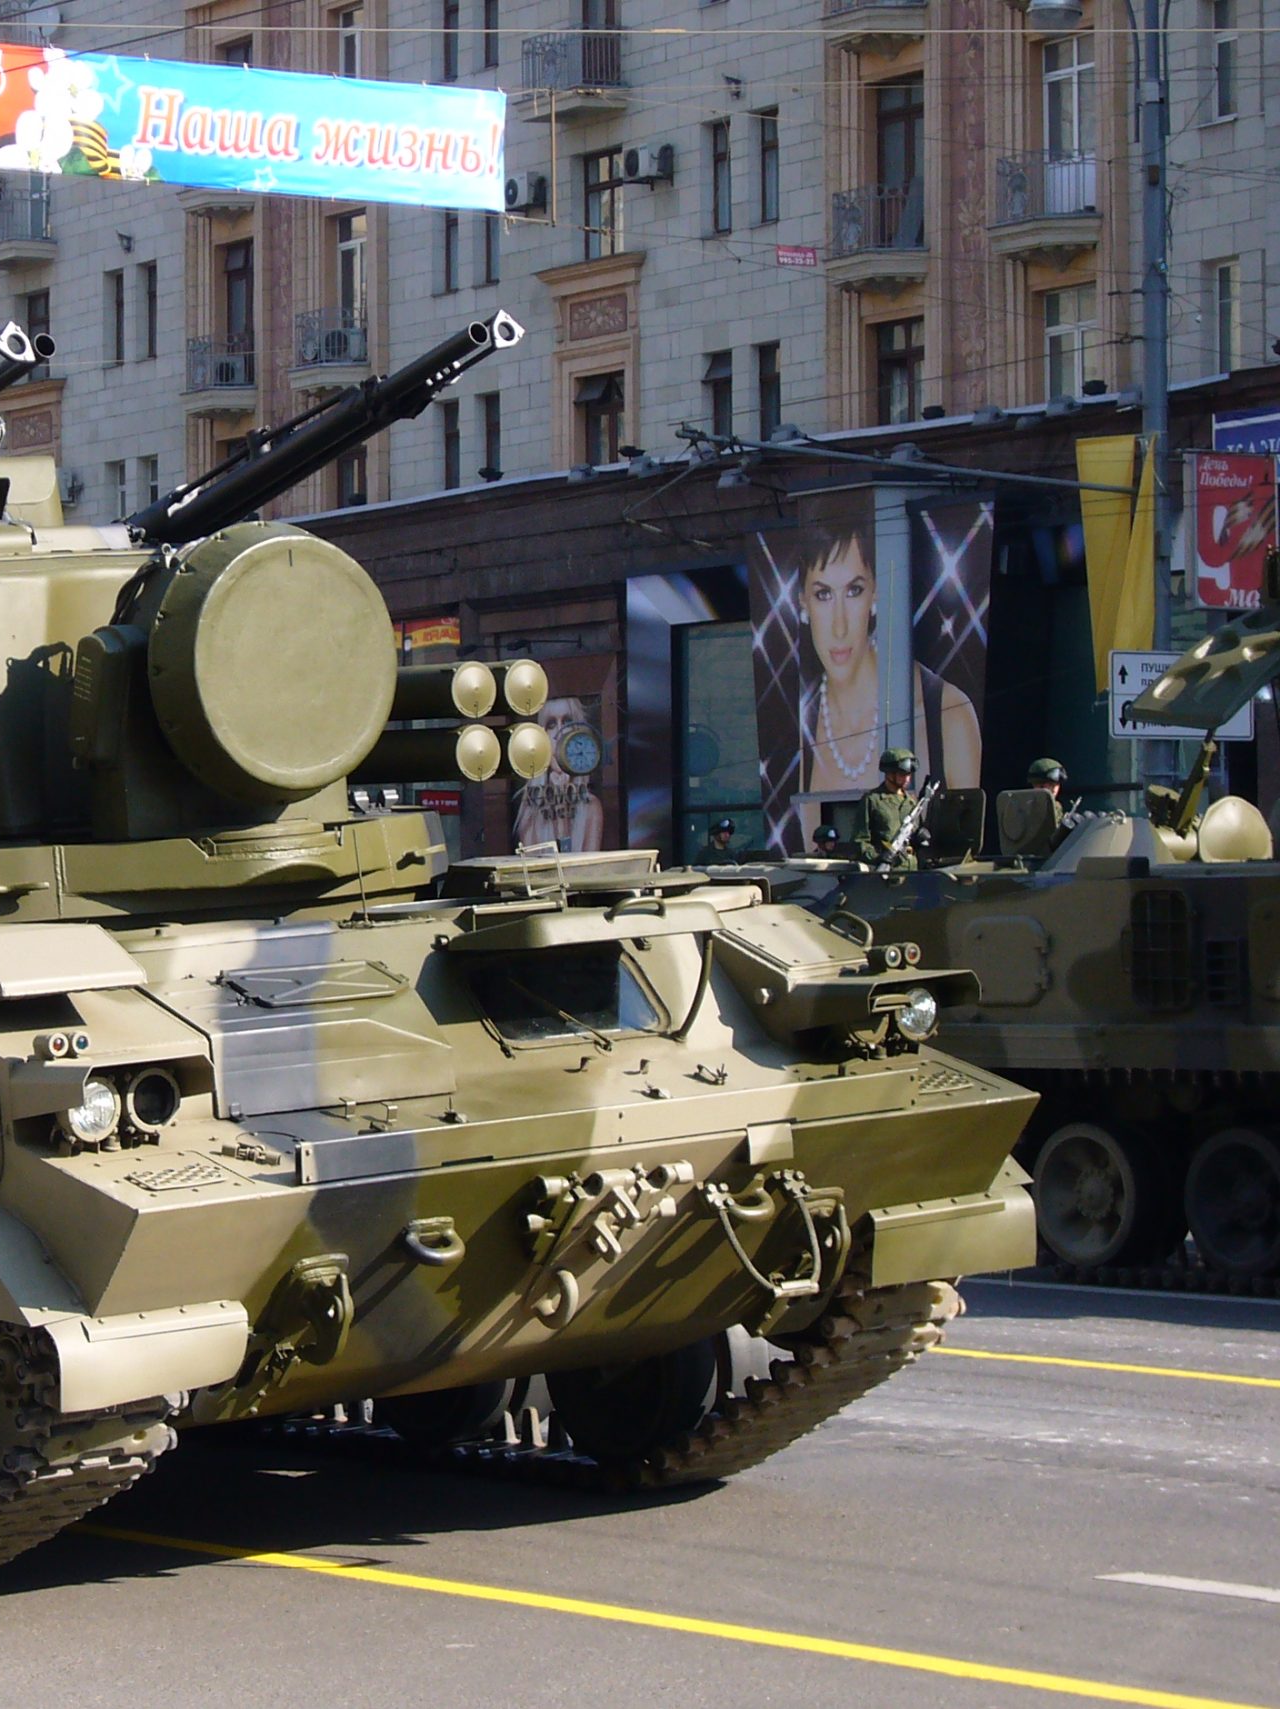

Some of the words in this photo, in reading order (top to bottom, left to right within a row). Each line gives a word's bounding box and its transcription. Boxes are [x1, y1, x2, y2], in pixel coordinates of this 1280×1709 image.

[135, 90, 298, 158] Наша
[314, 121, 503, 174] жизнь!
[1199, 456, 1229, 472] День
[1200, 472, 1254, 488] Победы!
